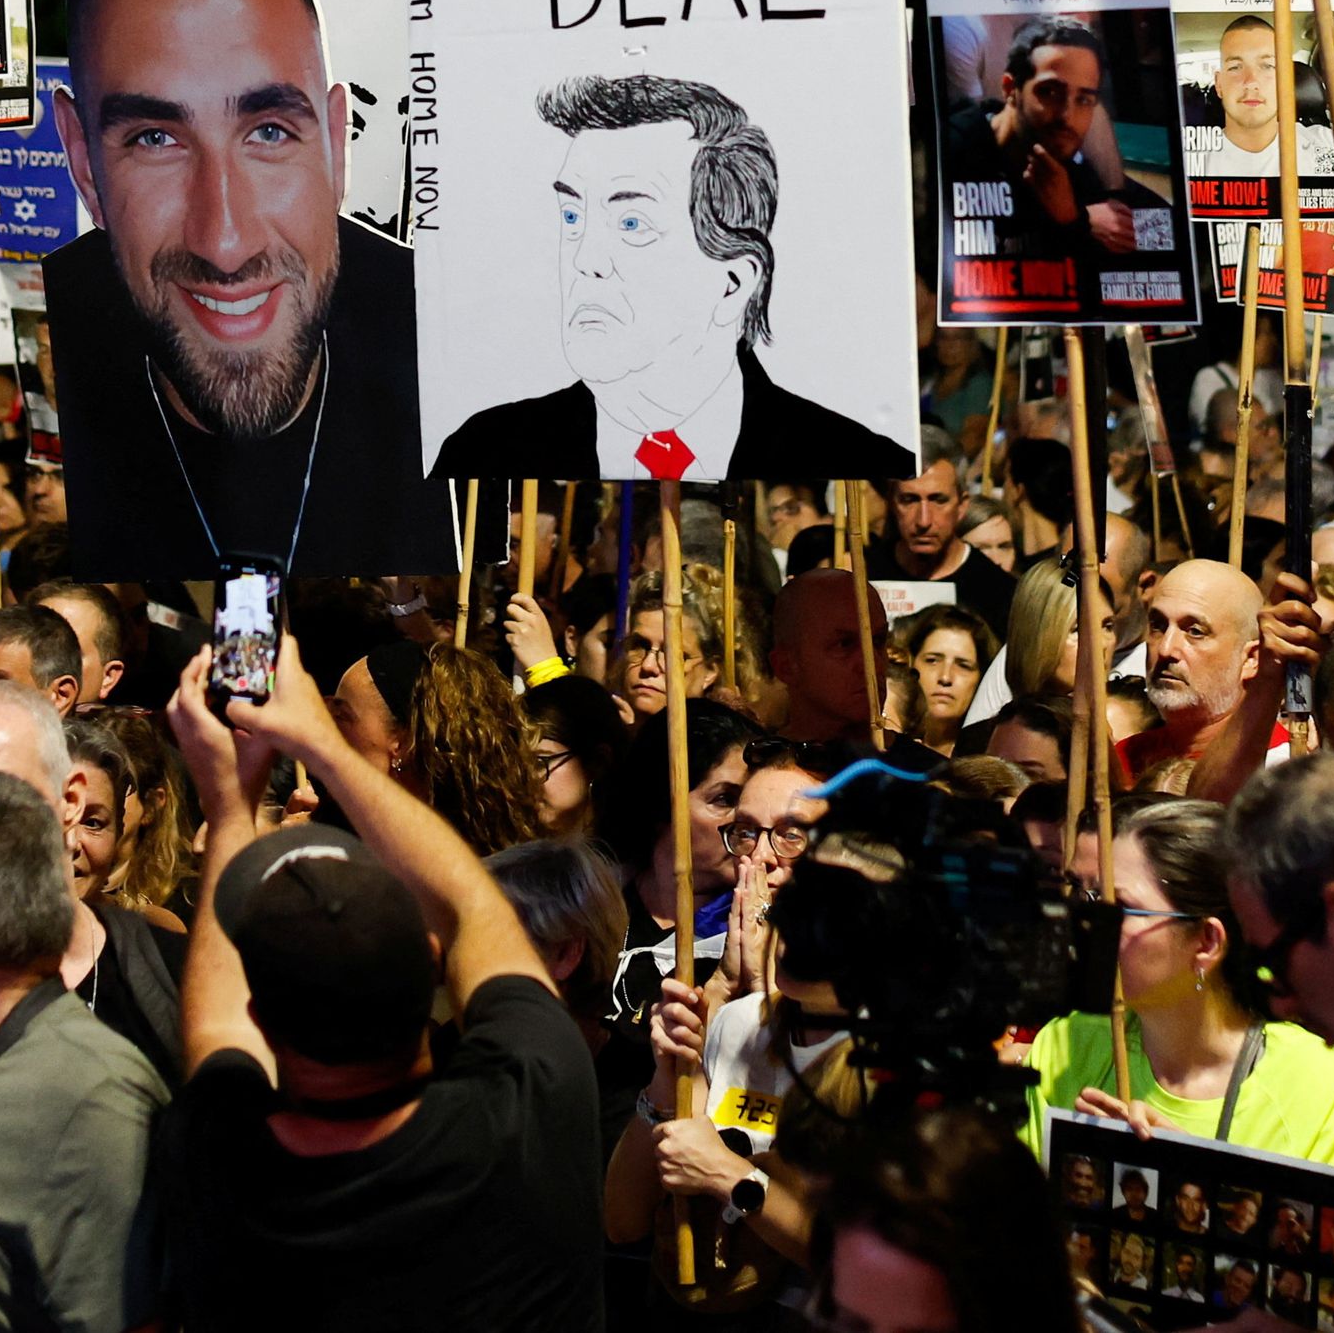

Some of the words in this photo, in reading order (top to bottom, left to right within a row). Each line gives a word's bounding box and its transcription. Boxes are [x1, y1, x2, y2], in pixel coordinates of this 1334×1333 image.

[410, 53, 439, 146] HOME
[413, 166, 440, 232] NOW
[953, 182, 1013, 217] BRING
[1223, 179, 1267, 206] NOW!
[954, 220, 996, 256] HIM
[954, 261, 1016, 298] HOME
[1101, 283, 1145, 300] FAMILIES
[1146, 283, 1183, 300] FORUM
[736, 1095, 778, 1125] 725
